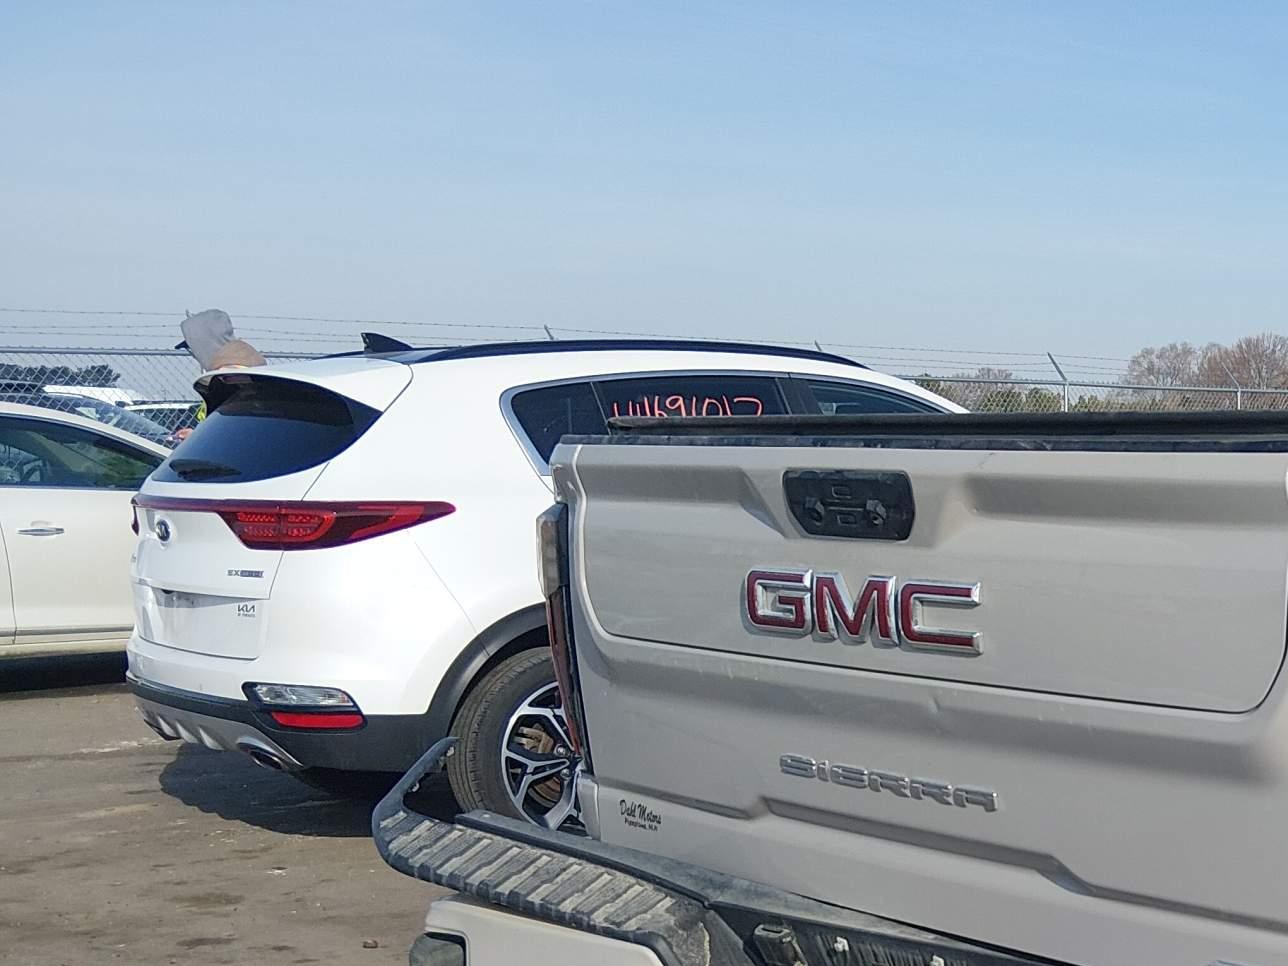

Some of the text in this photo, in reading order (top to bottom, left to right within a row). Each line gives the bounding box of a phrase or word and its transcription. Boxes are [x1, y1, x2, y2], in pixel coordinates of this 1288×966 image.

[237, 604, 256, 613] KIA
[744, 569, 984, 657] GMC
[779, 753, 998, 812] SIERRA
